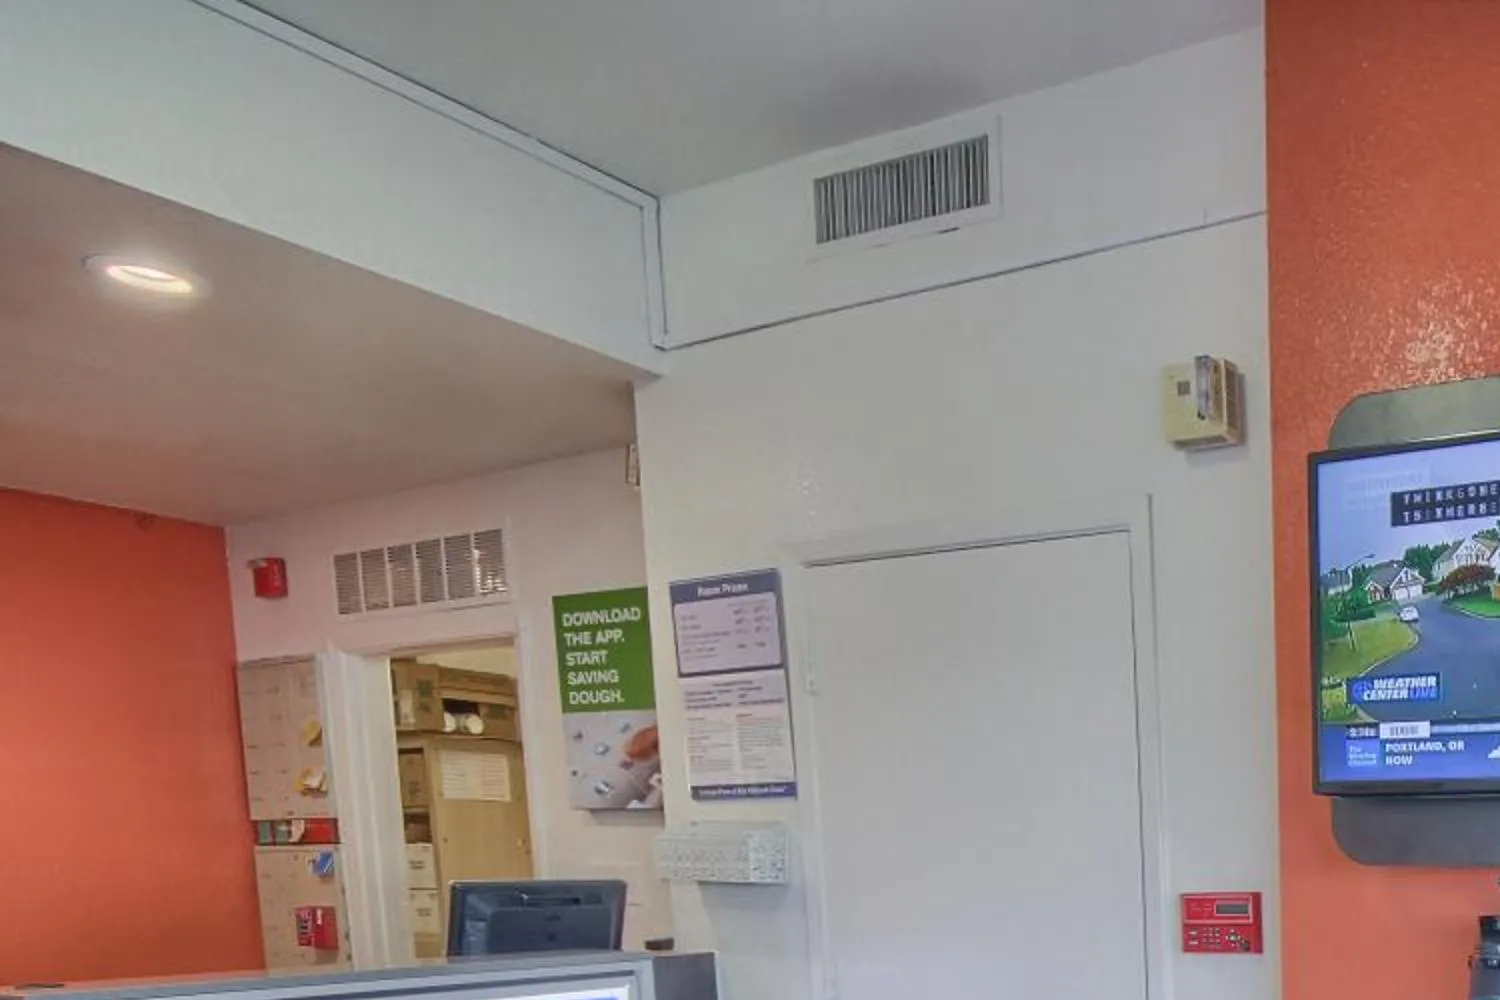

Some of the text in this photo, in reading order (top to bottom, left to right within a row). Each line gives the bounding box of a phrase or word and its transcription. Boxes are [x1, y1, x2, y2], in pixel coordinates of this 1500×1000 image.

[562, 607, 641, 627] DOWNLOAD
[563, 628, 626, 647] THE APP.
[565, 650, 609, 666] START
[567, 669, 620, 686] SAVING
[1373, 675, 1437, 690] WEATHER
[569, 690, 626, 705] DOUGH.
[1363, 688, 1409, 701] CENTER
[1385, 739, 1465, 754] PORTLAND, OR
[1385, 754, 1413, 766] NOW
